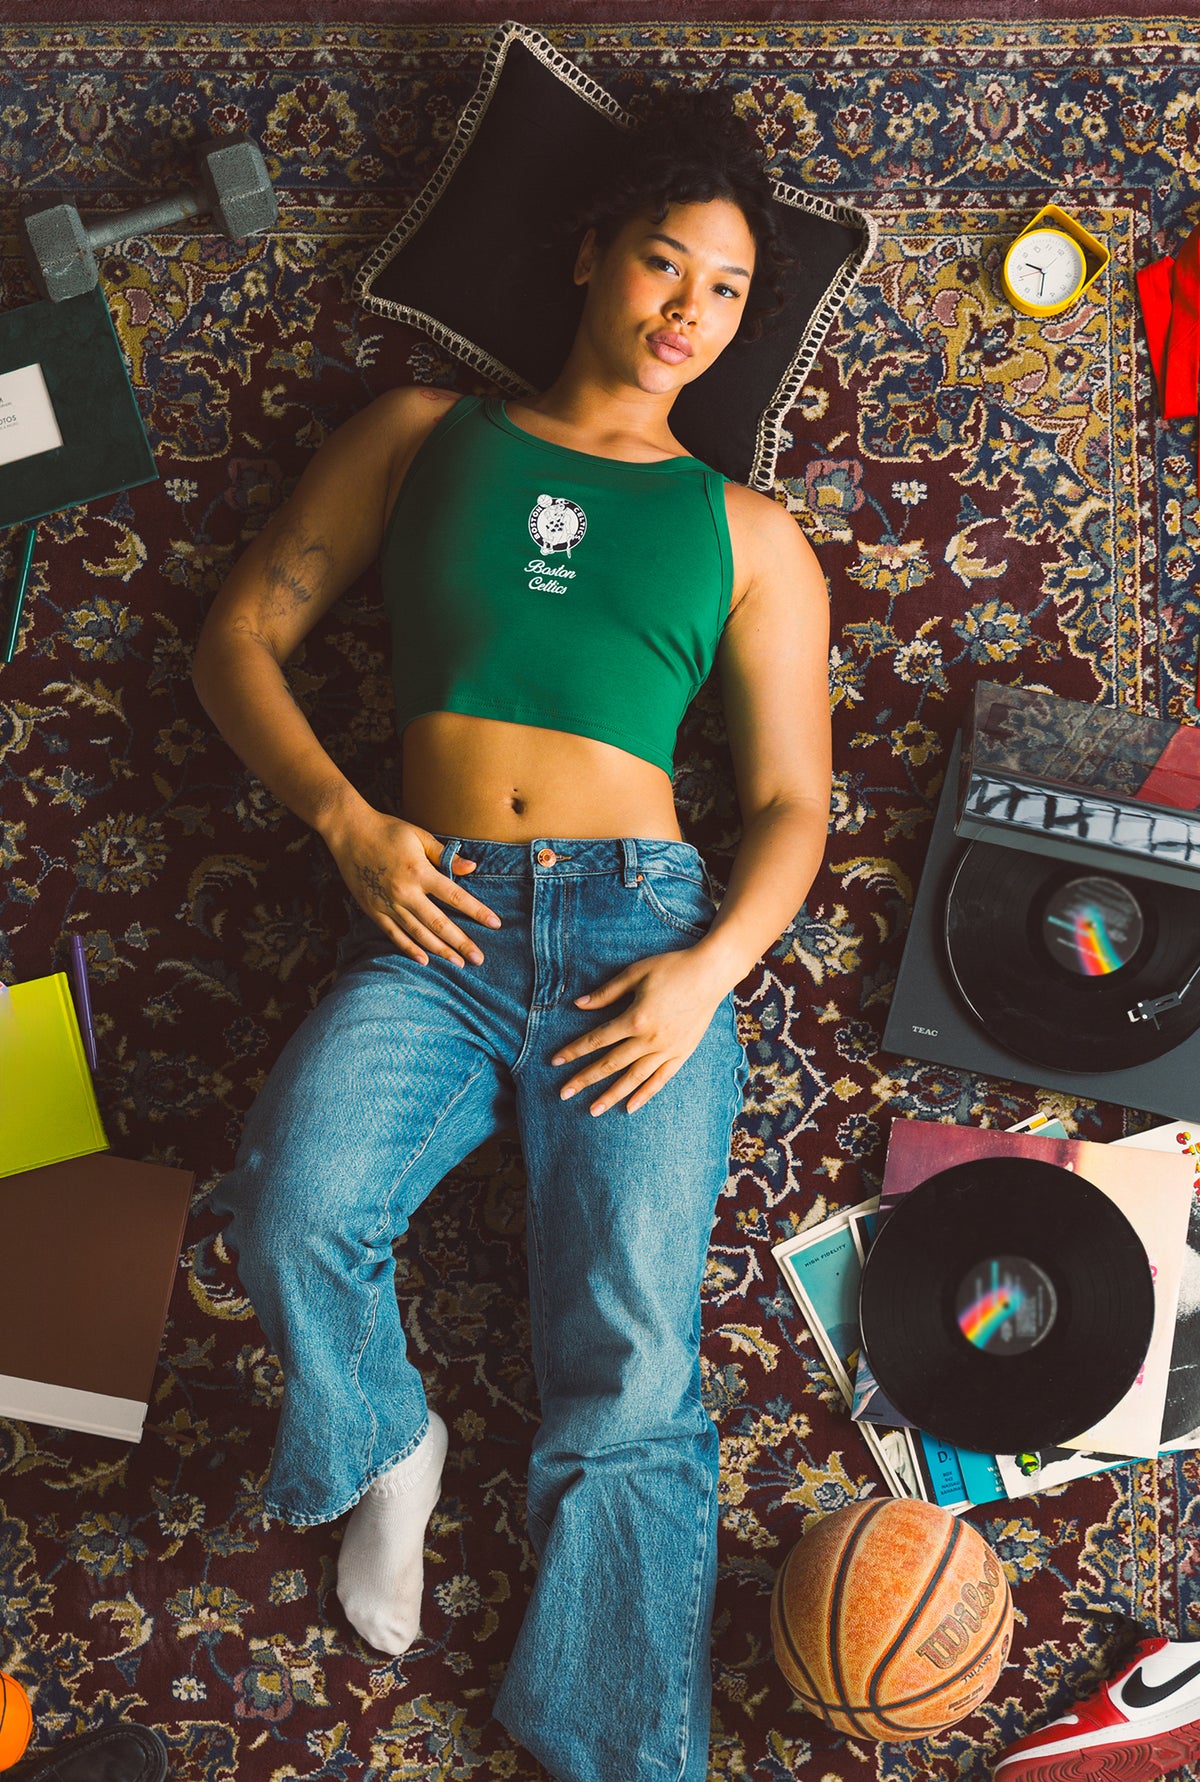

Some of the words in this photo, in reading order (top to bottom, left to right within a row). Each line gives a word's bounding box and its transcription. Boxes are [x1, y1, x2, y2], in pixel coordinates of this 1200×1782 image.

[530, 506, 544, 540] BOSTON
[572, 507, 586, 541] CELTICS
[524, 559, 577, 579] Boston
[528, 576, 568, 595] Celtics
[912, 1025, 939, 1037] TEAC
[804, 1257, 819, 1267] HIGH
[821, 1244, 846, 1259] FIDELITY
